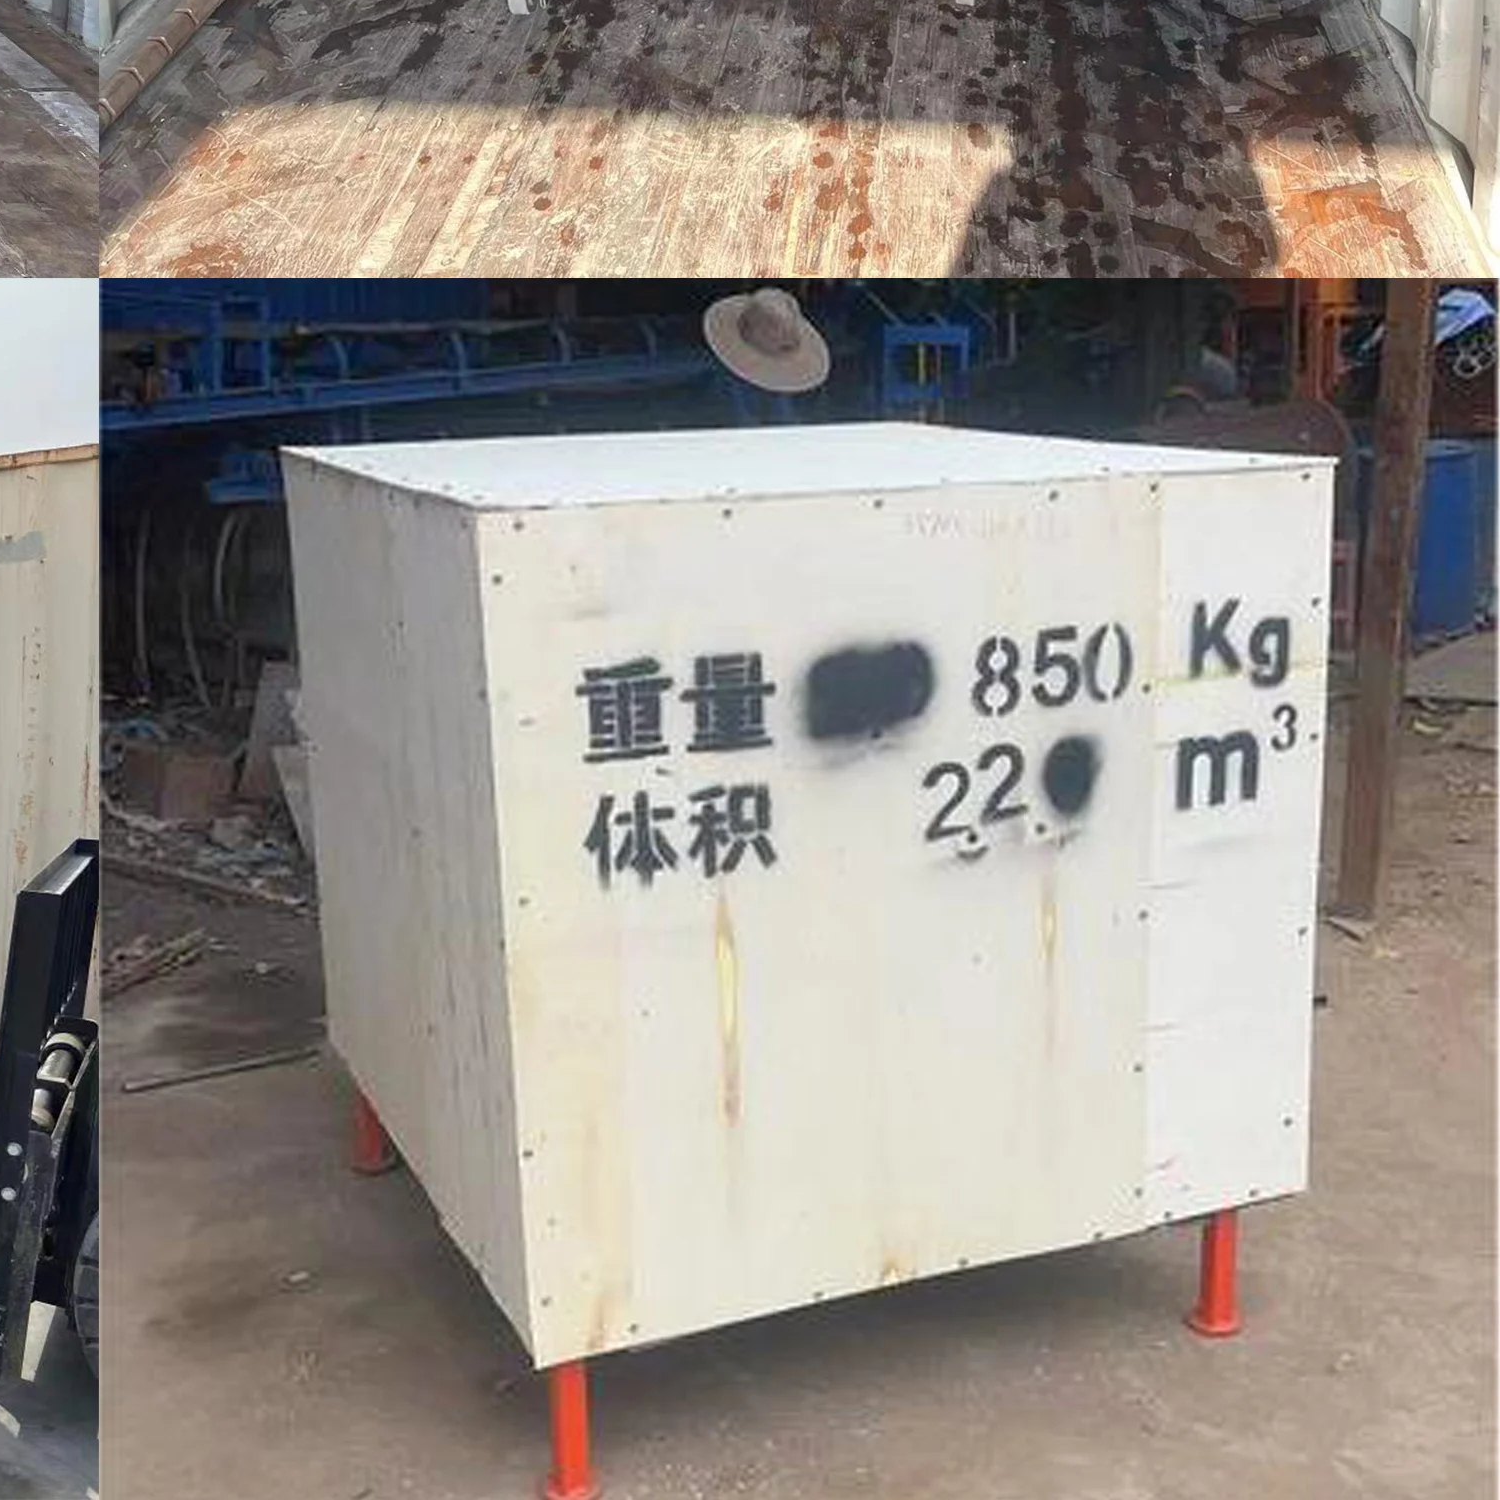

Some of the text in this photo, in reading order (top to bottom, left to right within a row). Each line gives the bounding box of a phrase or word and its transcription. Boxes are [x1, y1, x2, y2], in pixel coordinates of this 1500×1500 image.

[575, 597, 1291, 763] 重量 850 Kg
[583, 782, 778, 891] 体积
